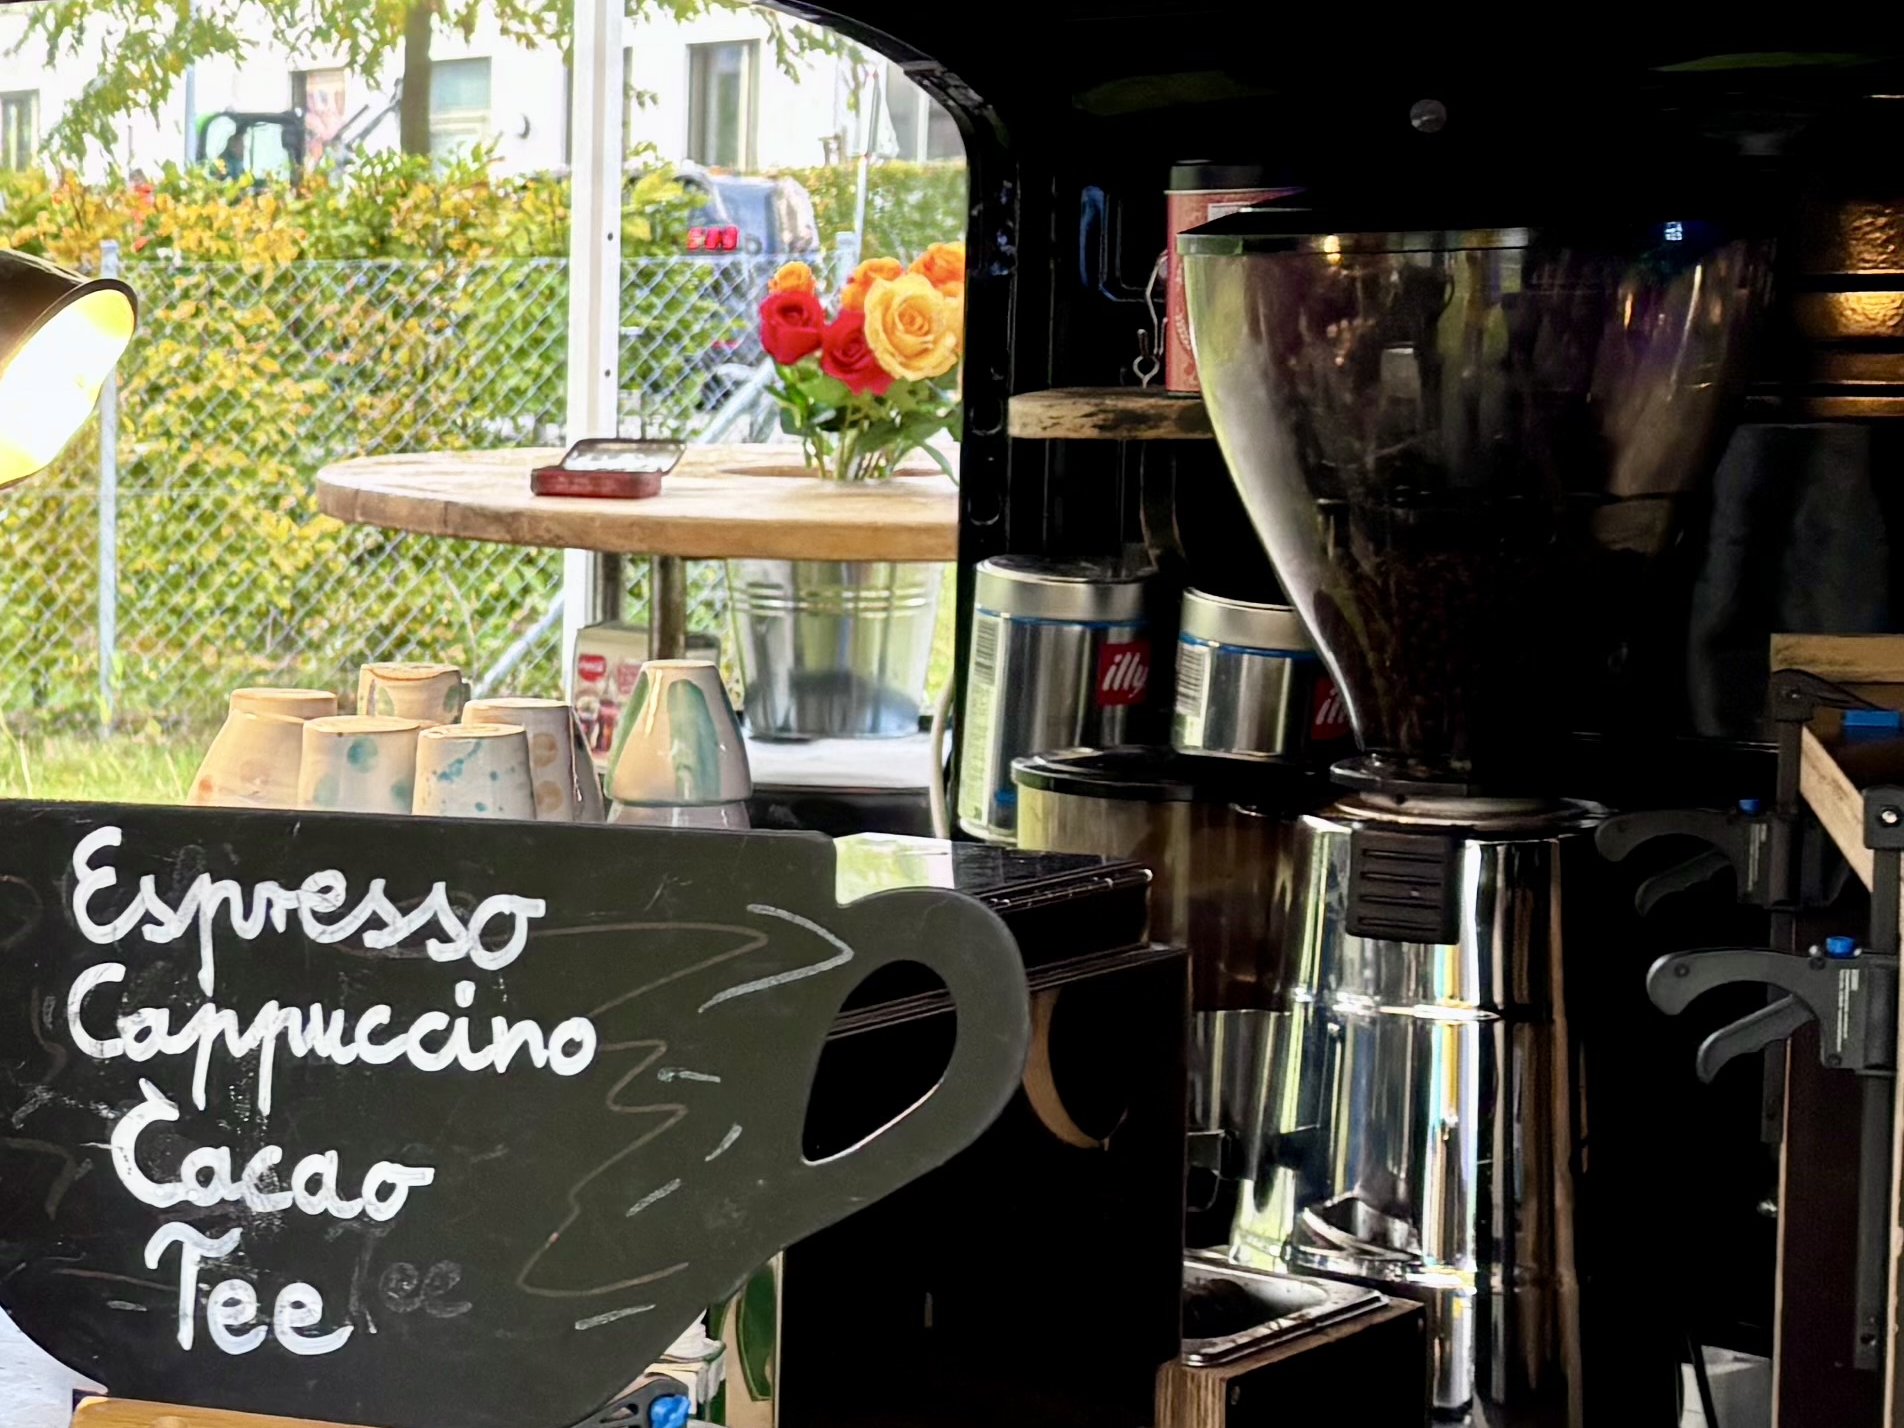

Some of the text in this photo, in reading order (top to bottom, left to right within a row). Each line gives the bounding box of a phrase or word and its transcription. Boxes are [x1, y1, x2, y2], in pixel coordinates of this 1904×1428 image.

[1102, 652, 1149, 699] illy
[71, 825, 546, 989] Espresso
[66, 963, 597, 1116] Cappuccino
[143, 1220, 354, 1356] Tee
